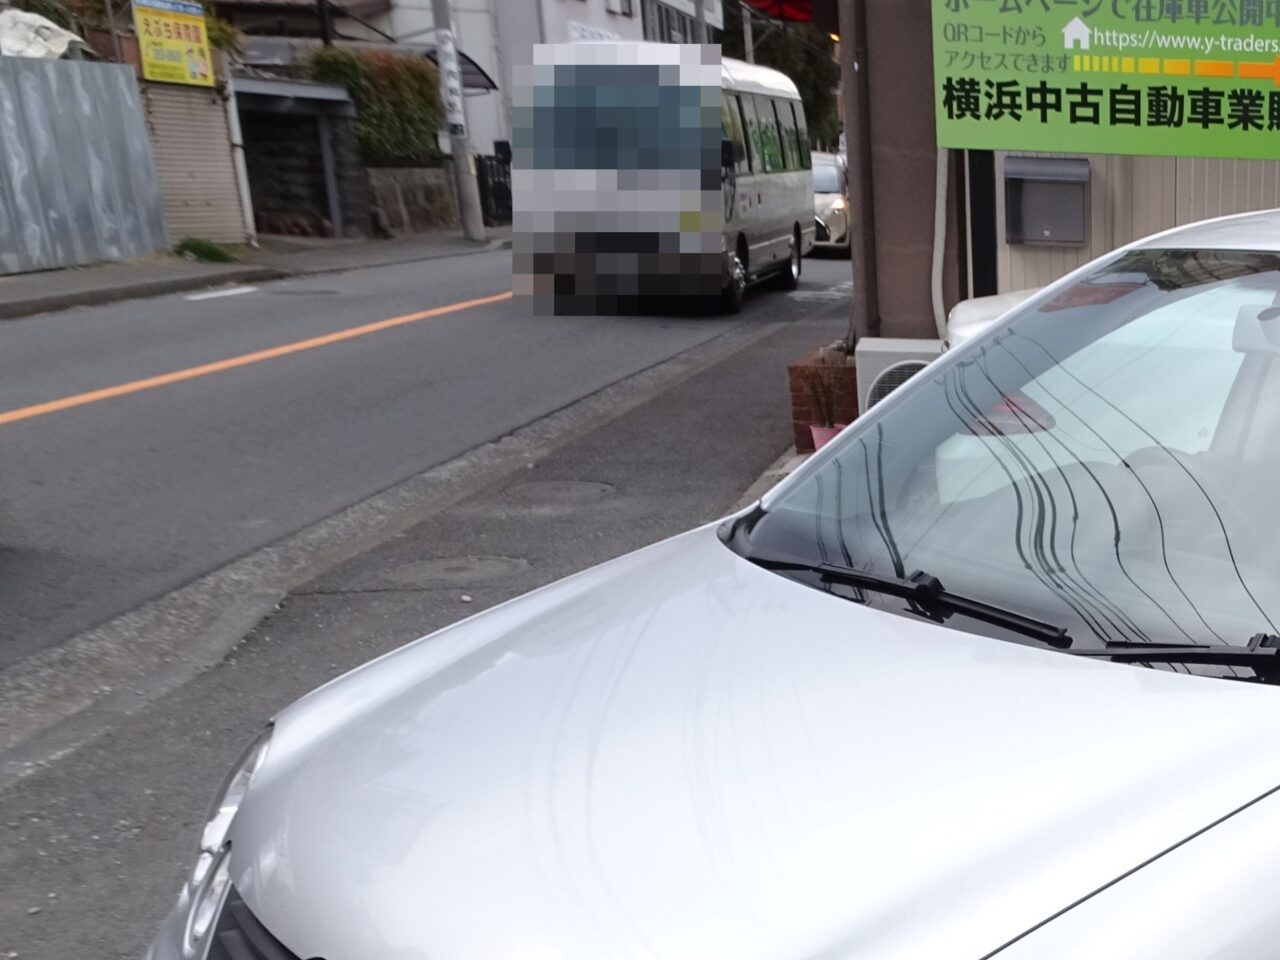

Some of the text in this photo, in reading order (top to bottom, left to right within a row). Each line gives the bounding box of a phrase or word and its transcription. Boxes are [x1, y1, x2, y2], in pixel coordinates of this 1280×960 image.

[943, 23, 1047, 47] QRコードから
[945, 50, 1071, 74] アクセスできます
